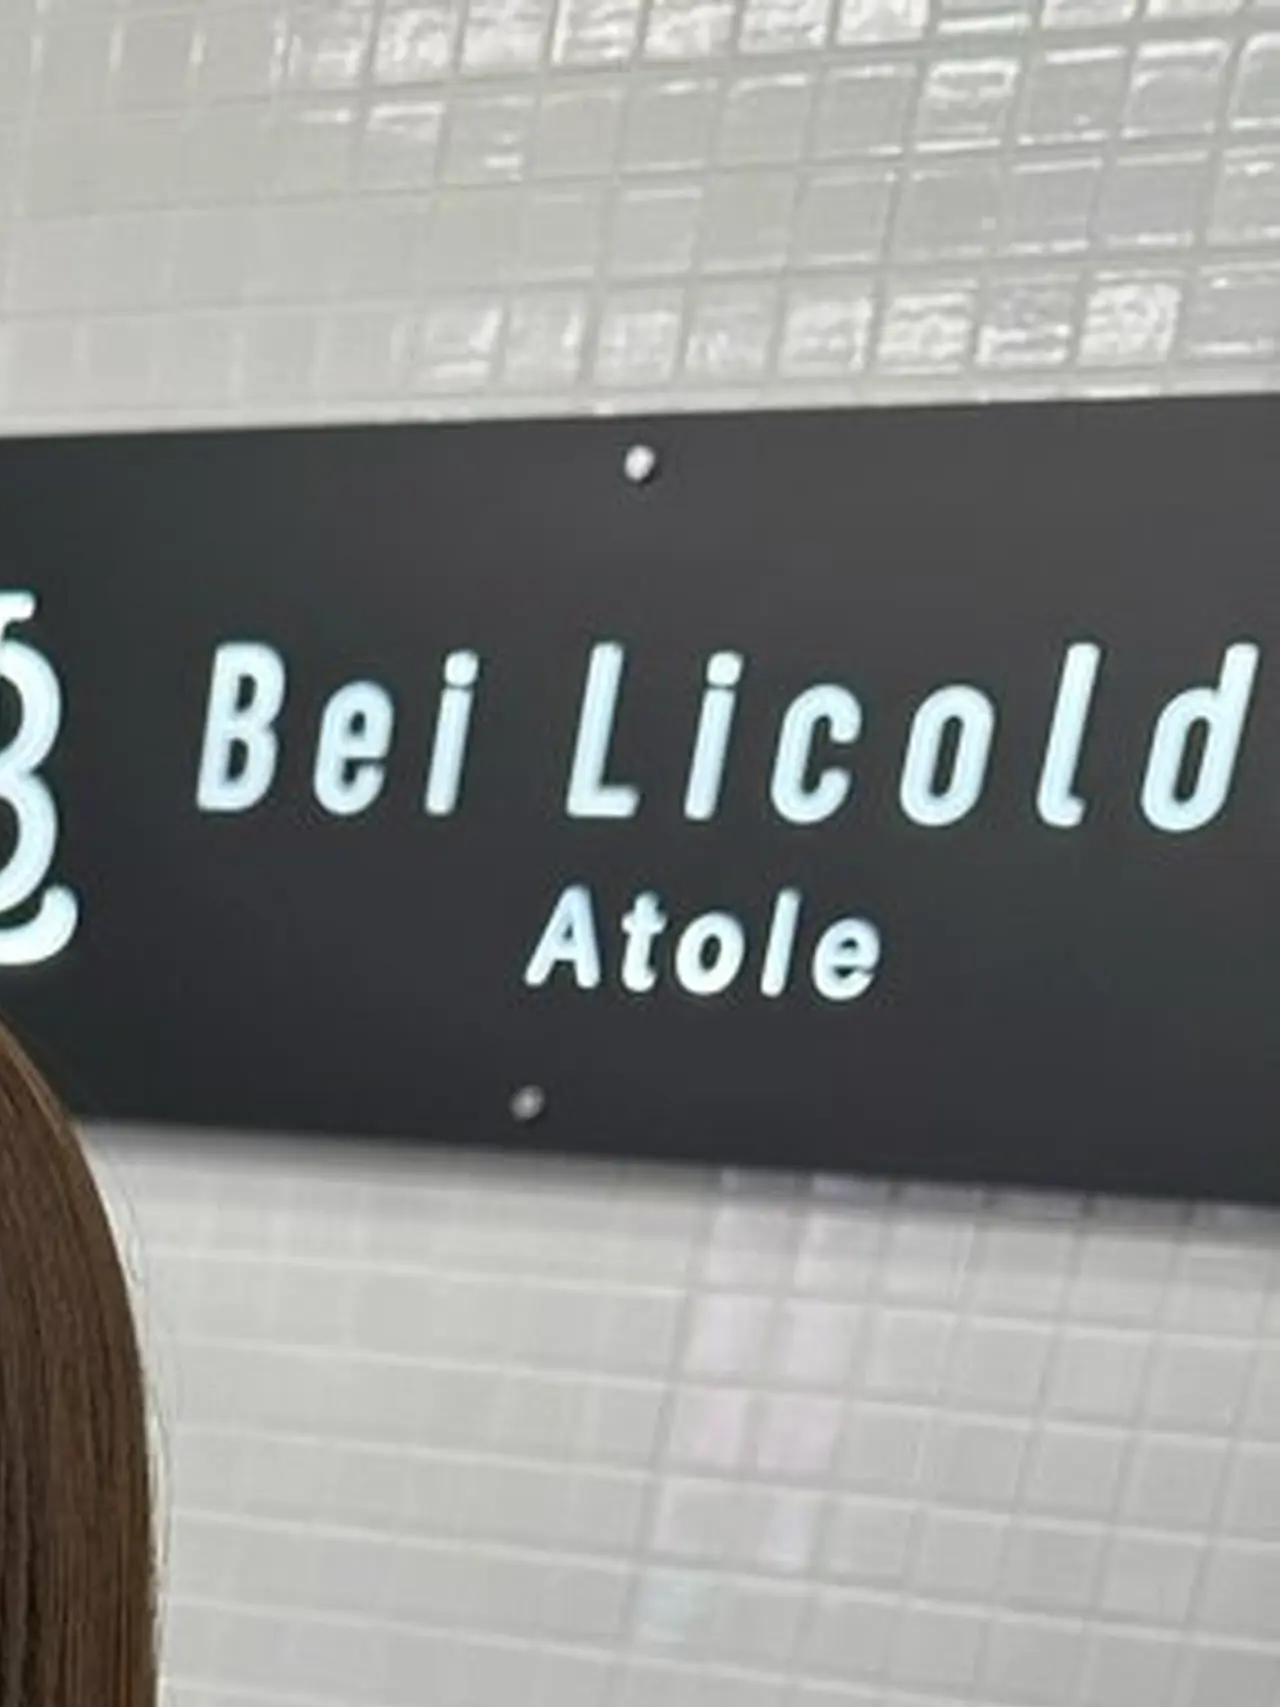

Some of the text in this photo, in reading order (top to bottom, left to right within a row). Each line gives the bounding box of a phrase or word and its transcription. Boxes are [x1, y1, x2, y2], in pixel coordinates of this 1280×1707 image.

[196, 642, 1259, 833] Bei Licold
[524, 886, 880, 1001] Atole
